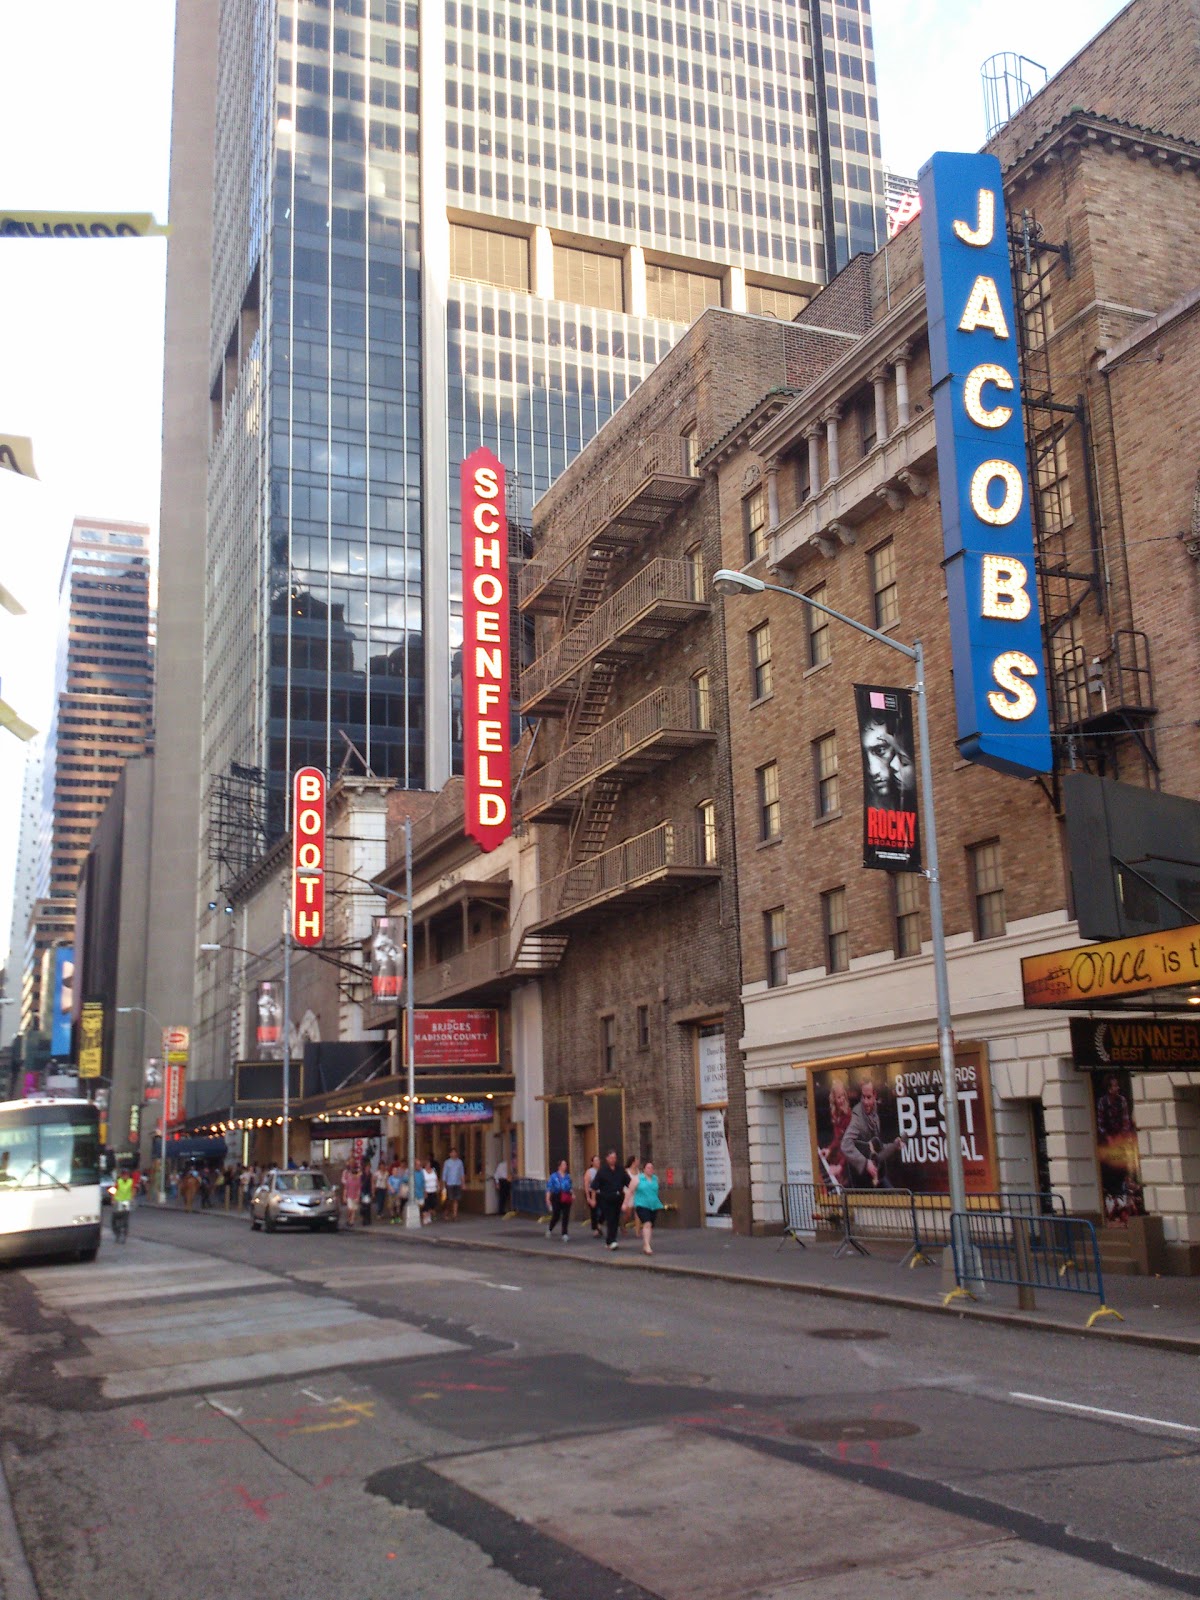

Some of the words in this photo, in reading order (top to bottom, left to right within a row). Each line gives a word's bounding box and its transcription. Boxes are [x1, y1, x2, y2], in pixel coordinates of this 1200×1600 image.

[952, 188, 1039, 722] JACOBS
[473, 467, 507, 826] SCHOENFELD
[867, 806, 916, 842] ROCKY
[867, 837, 915, 848] BROADWAY
[299, 775, 322, 938] BOOTH
[1071, 949, 1152, 993] Once
[414, 1033, 452, 1041] MADISON
[453, 1032, 488, 1041] COUNTY
[432, 1022, 471, 1032] BRIDGES
[1108, 1024, 1199, 1047] WINNER
[1111, 1047, 1144, 1061] BEST
[895, 1073, 905, 1096] 8
[903, 1070, 931, 1087] TONY
[901, 1135, 984, 1164] MUSIAL
